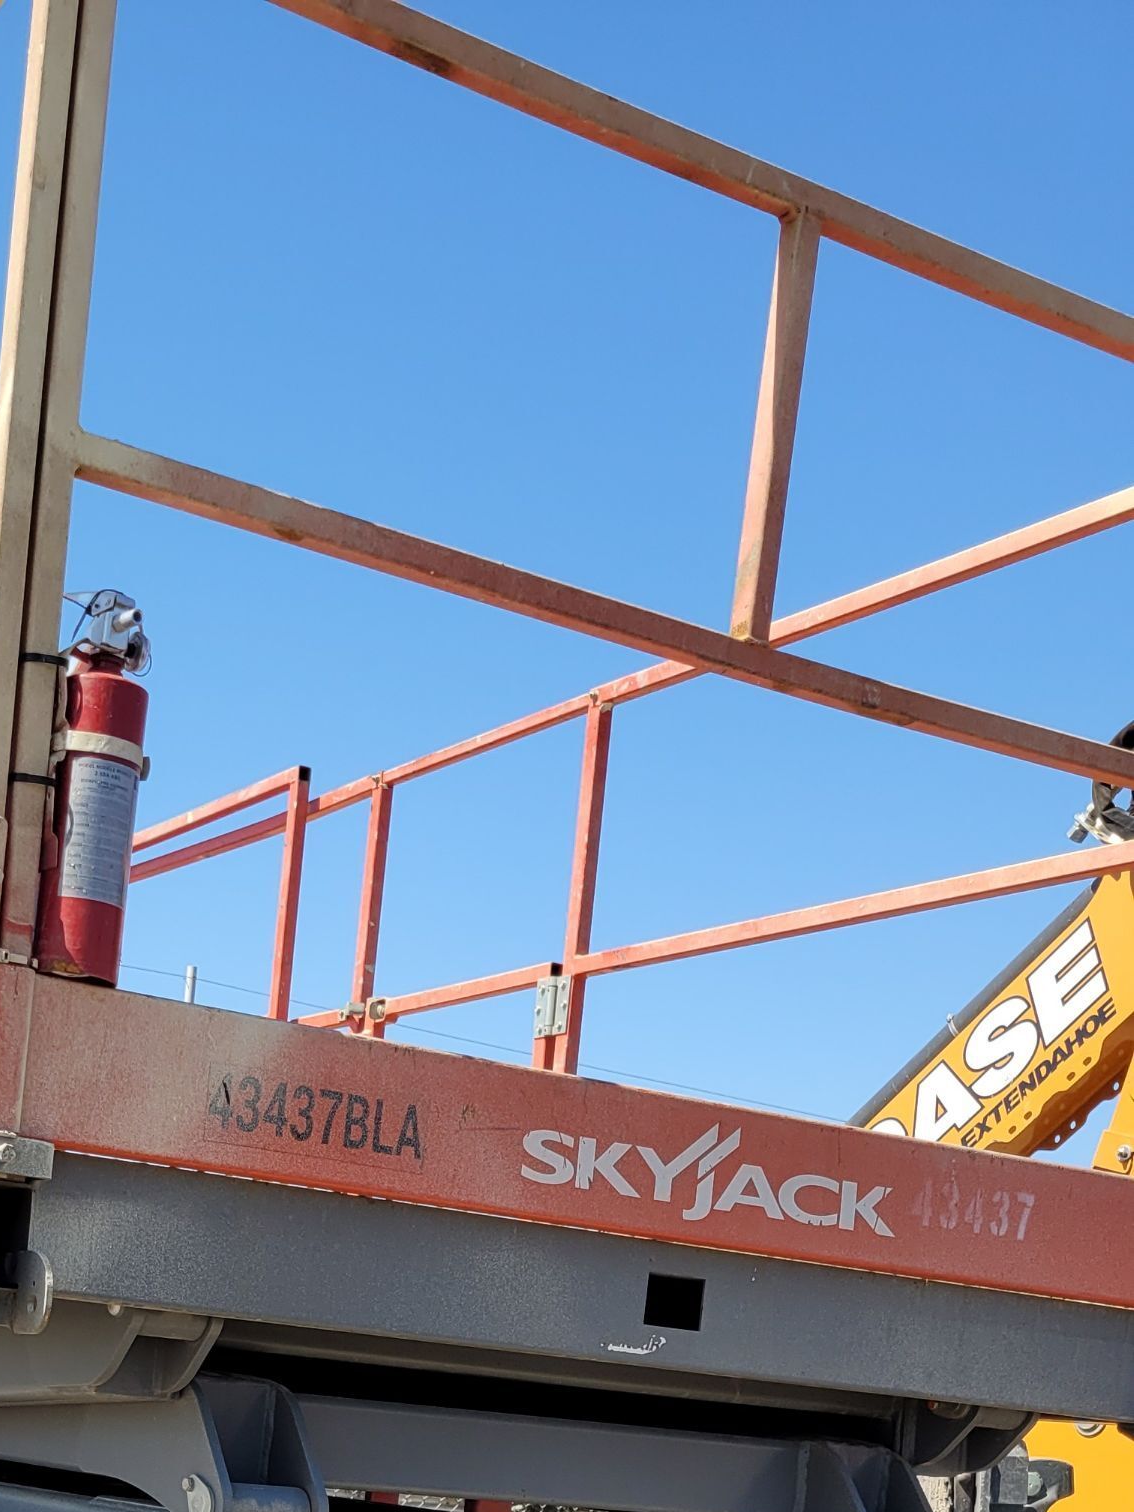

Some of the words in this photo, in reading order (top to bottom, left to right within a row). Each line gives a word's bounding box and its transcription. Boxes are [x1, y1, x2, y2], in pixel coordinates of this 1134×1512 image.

[208, 1072, 422, 1160] 43437BLA
[961, 997, 1117, 1148] EXTENDAHOE
[521, 1122, 896, 1238] SKYJACK
